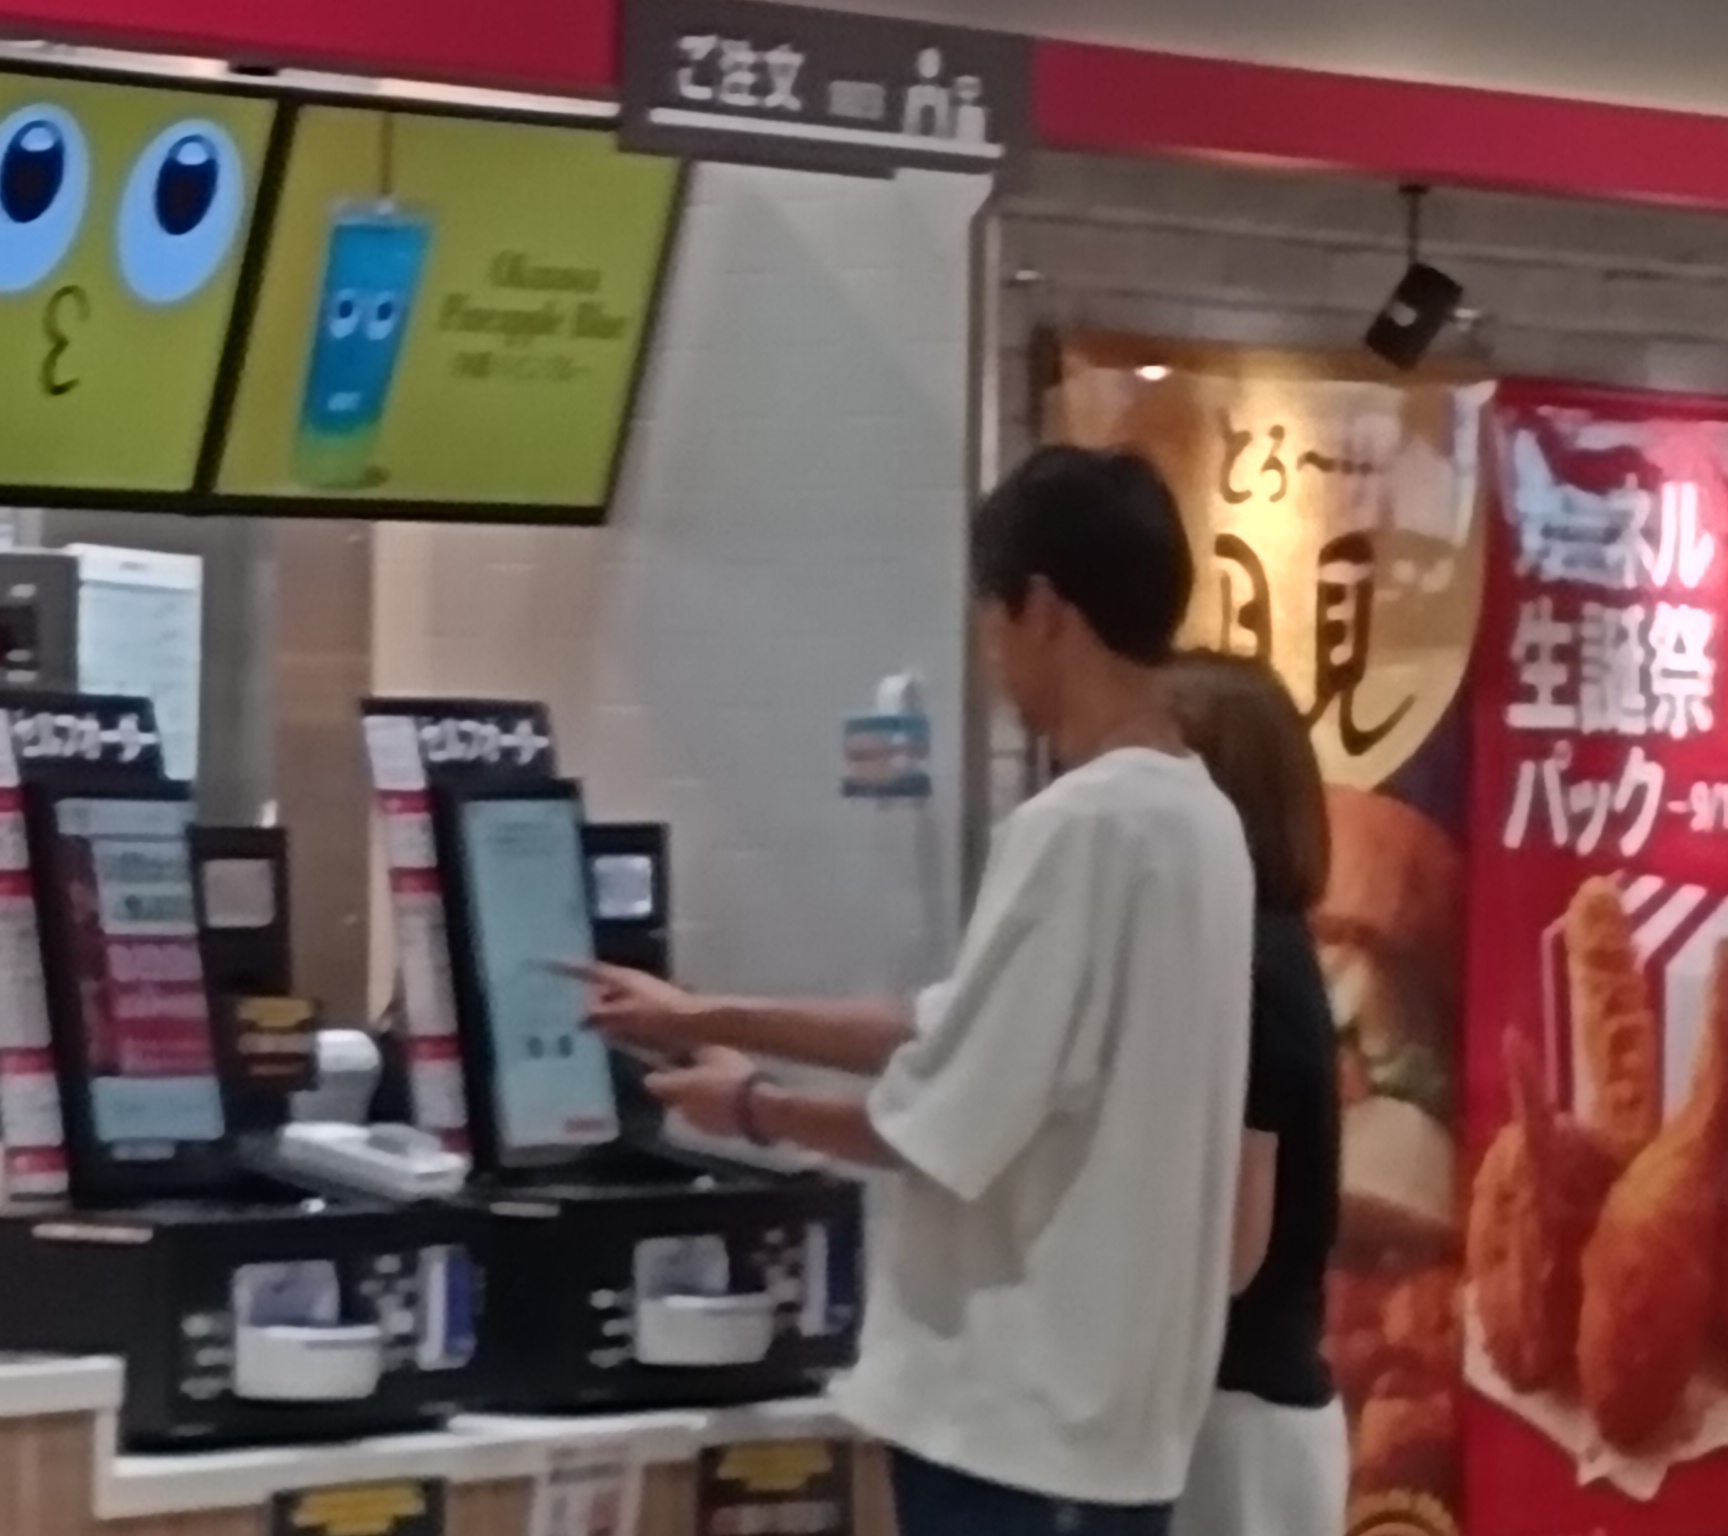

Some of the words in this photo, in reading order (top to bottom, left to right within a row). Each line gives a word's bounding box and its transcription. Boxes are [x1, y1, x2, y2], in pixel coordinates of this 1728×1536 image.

[677, 33, 805, 112] ご注文
[1504, 596, 1714, 739] 生誕祭
[1503, 739, 1665, 858] パック
